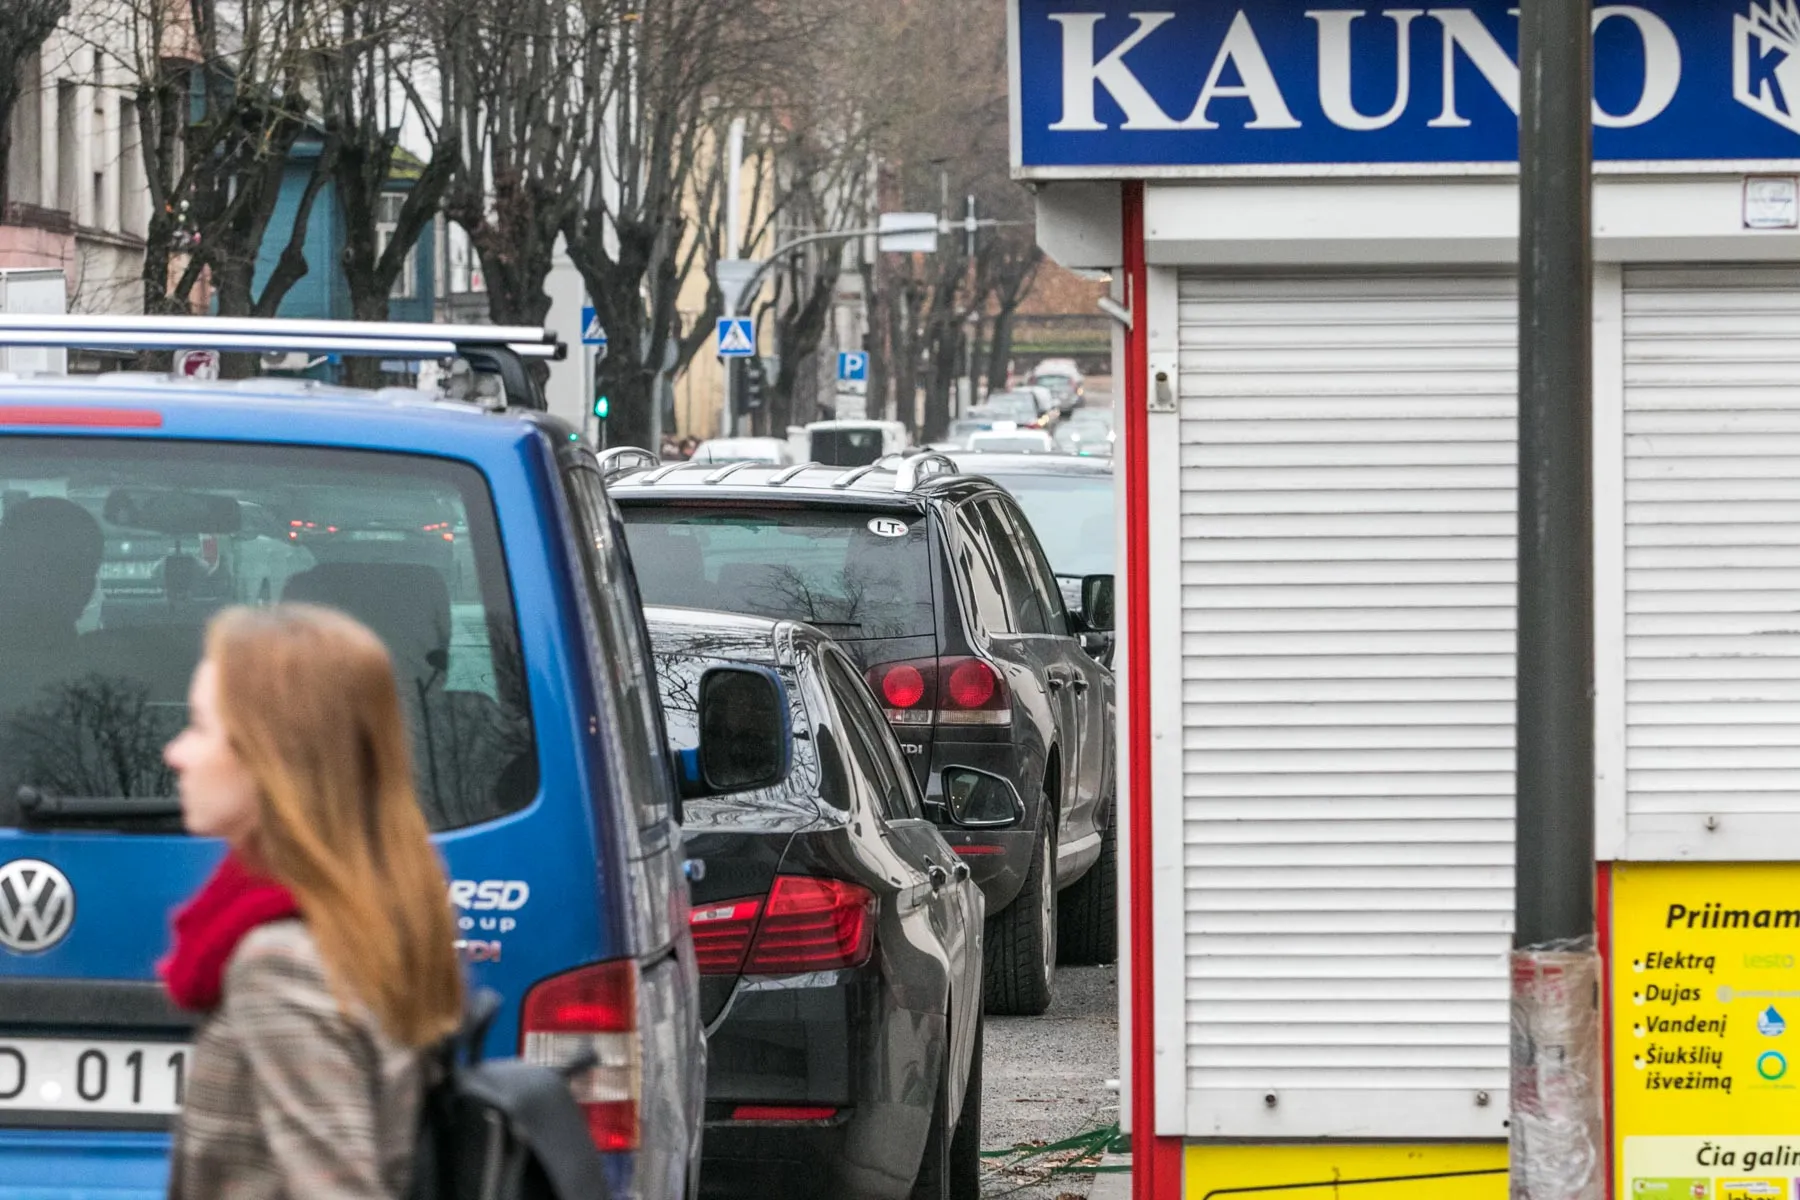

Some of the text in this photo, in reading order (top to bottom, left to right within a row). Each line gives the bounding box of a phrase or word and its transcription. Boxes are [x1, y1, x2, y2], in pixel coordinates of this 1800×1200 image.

[1048, 5, 1682, 131] KAUNO
[845, 354, 863, 377] P
[877, 520, 900, 534] LT
[900, 743, 923, 755] TDI
[458, 916, 516, 934] oup
[1666, 902, 1800, 929] Priimam
[1645, 951, 1715, 974] Elektrą
[1645, 983, 1701, 1006] Dujas
[1646, 1014, 1727, 1038] Vandenį
[1645, 1043, 1723, 1069] Šiukšlių
[77, 1048, 185, 1105] 011
[1645, 1071, 1732, 1095] išvežimą
[1697, 1142, 1736, 1167] Čia
